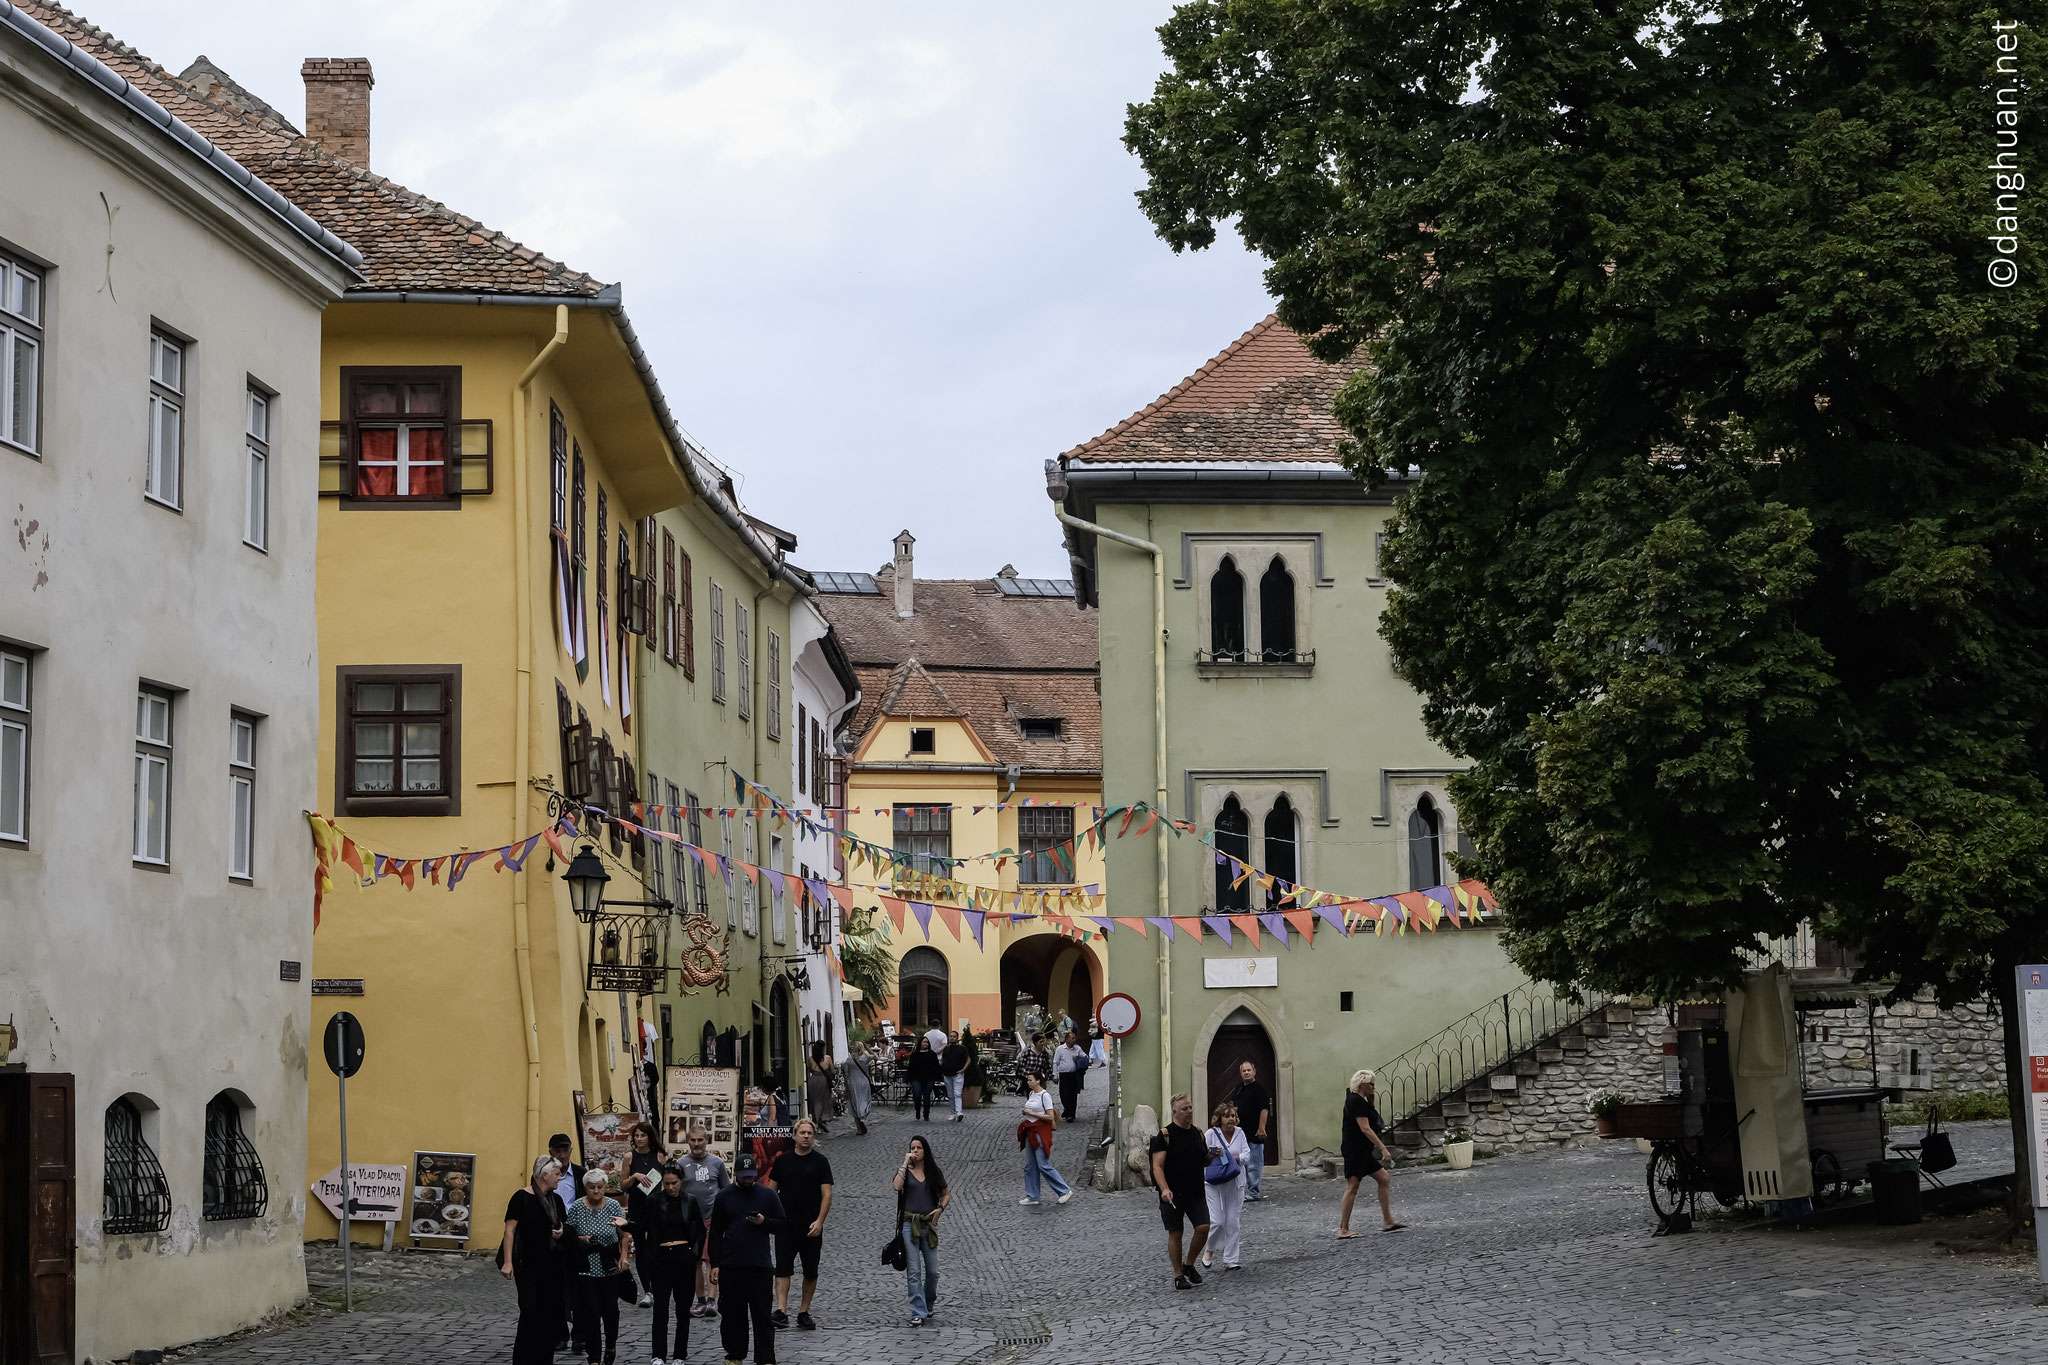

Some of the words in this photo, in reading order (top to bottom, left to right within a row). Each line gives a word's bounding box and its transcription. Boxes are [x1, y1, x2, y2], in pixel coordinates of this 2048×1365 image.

[674, 1069, 690, 1077] CASA
[691, 1070, 707, 1078] VLAD
[708, 1071, 731, 1079] DRACUL
[359, 1169, 376, 1180] VLAD
[378, 1169, 401, 1181] DRACUL
[319, 1180, 349, 1196] TERAS
[353, 1181, 401, 1199] INTERIOARA
